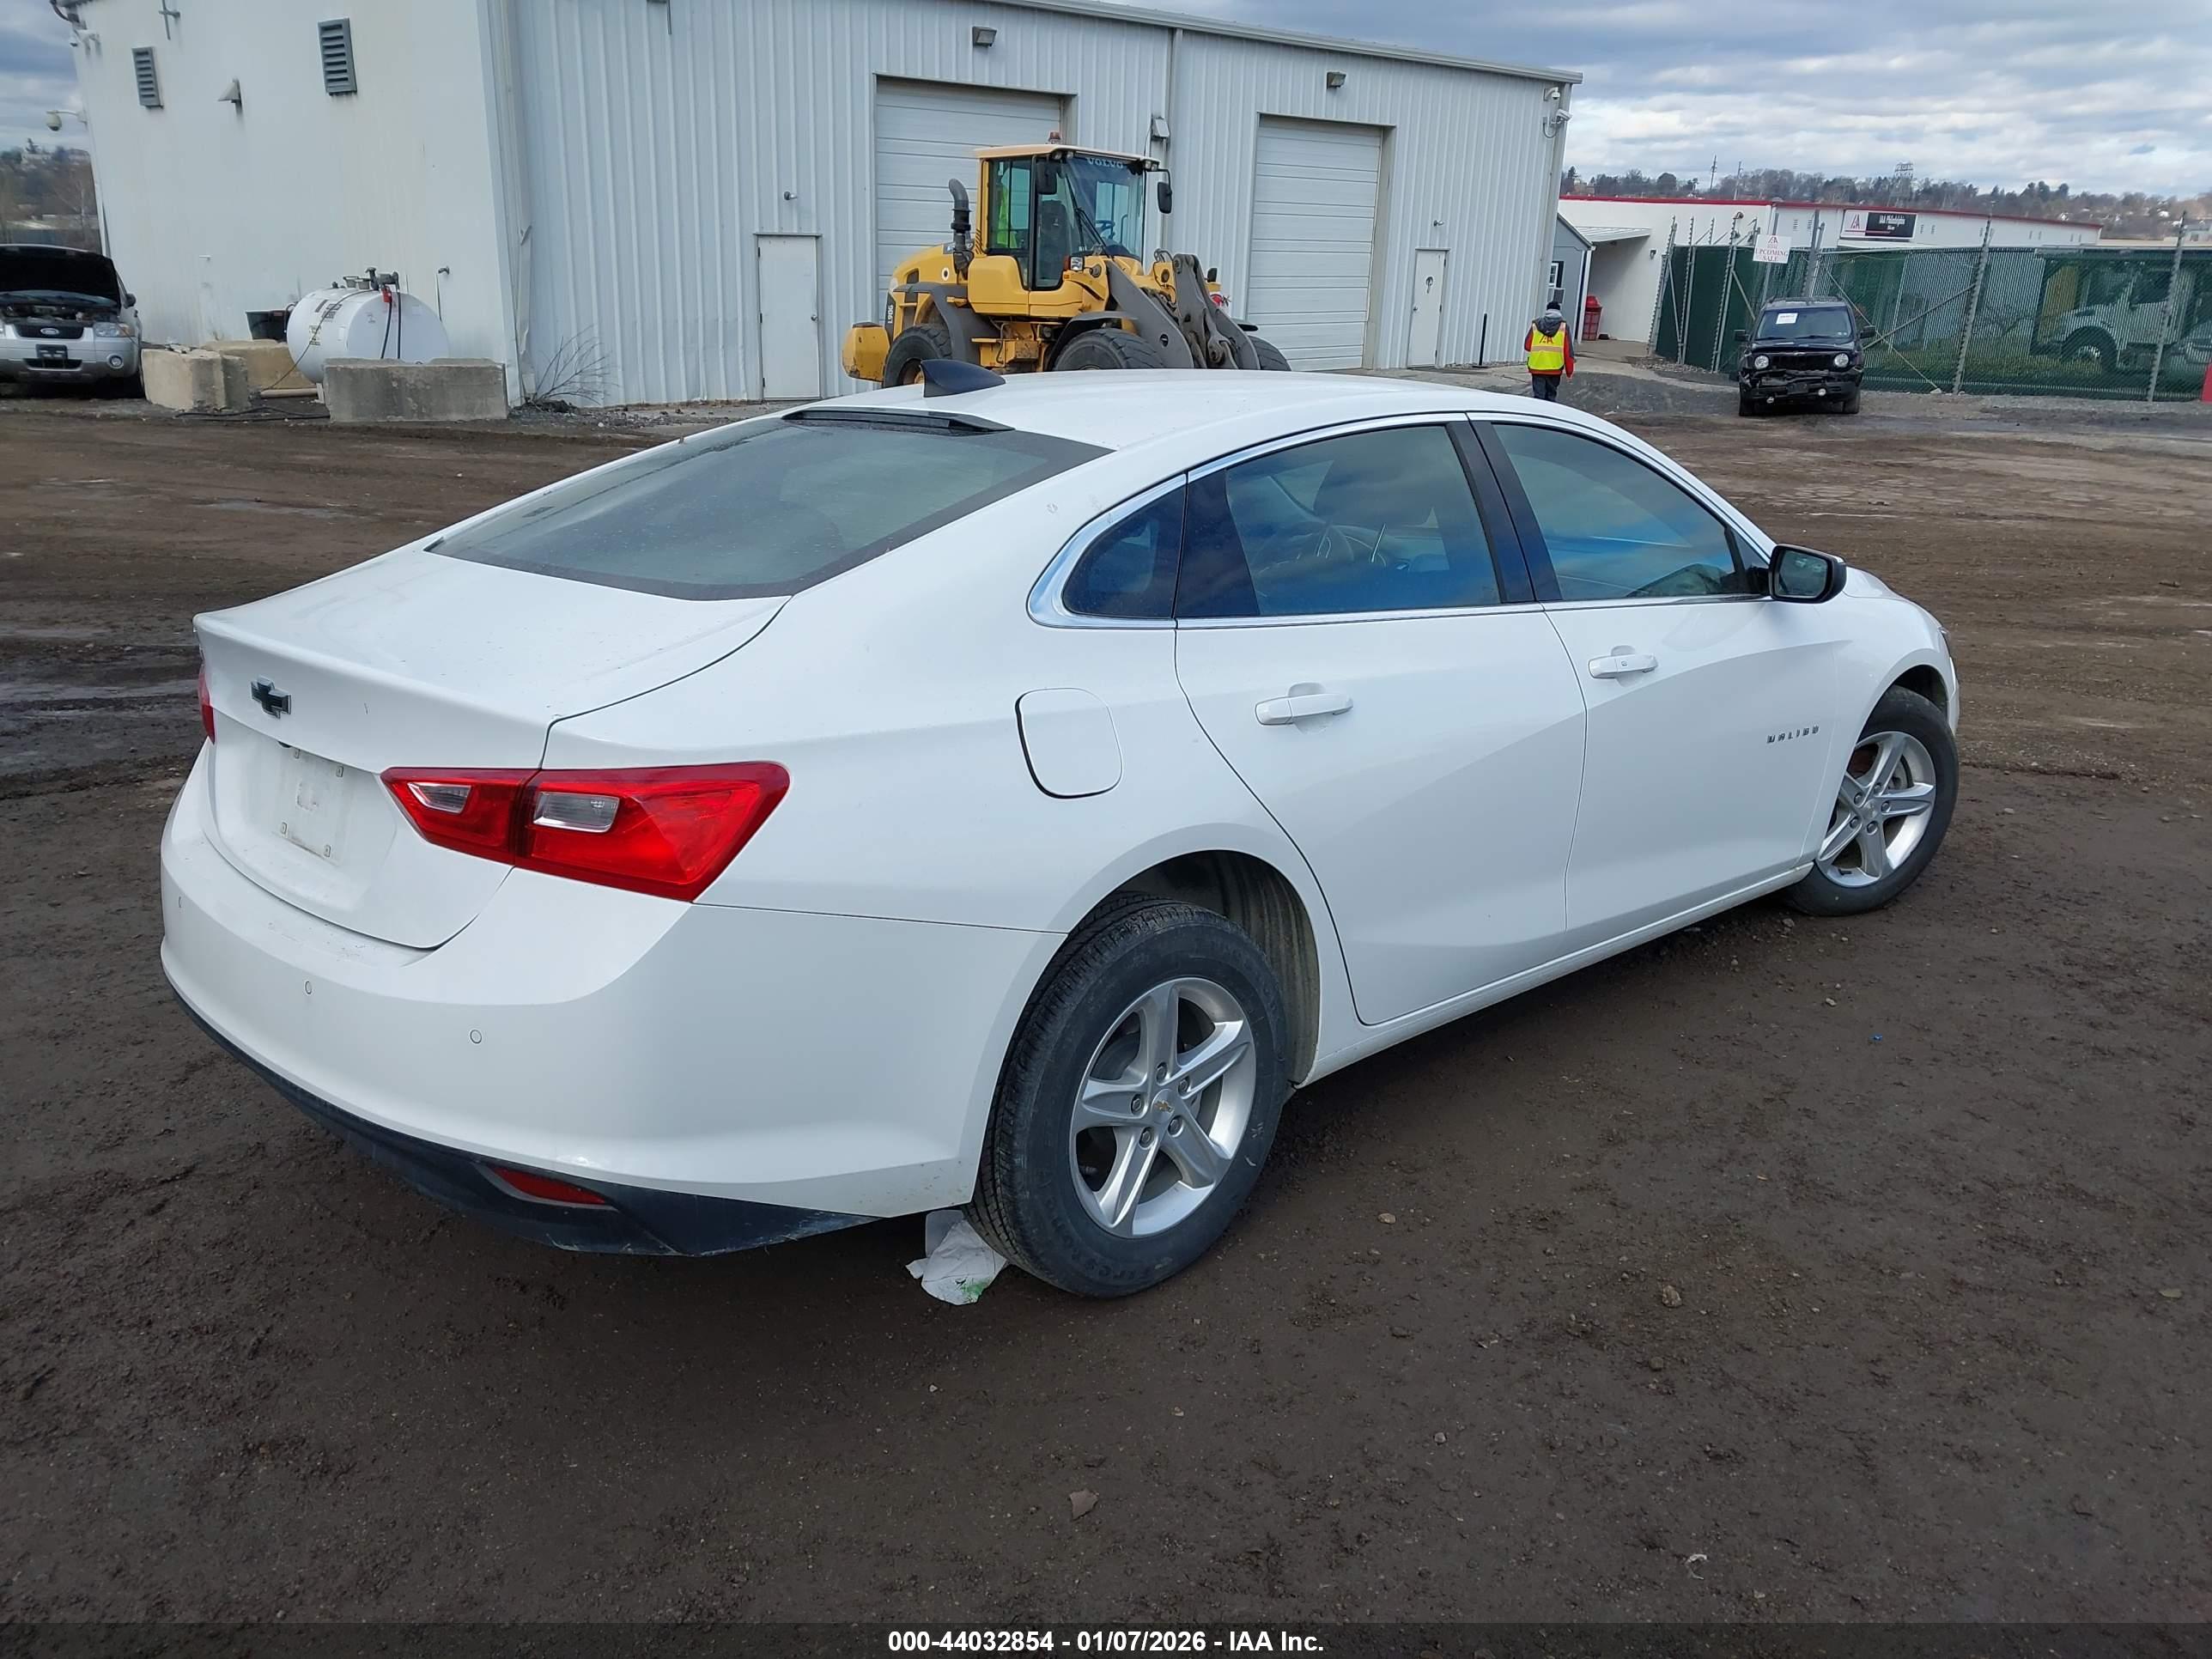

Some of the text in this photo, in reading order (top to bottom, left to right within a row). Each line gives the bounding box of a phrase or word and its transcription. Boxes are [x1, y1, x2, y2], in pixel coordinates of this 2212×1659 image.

[1085, 156, 1125, 169] VOLVO
[1755, 247, 1789, 257] UPCOMING
[1766, 725, 1820, 744] MALIBU
